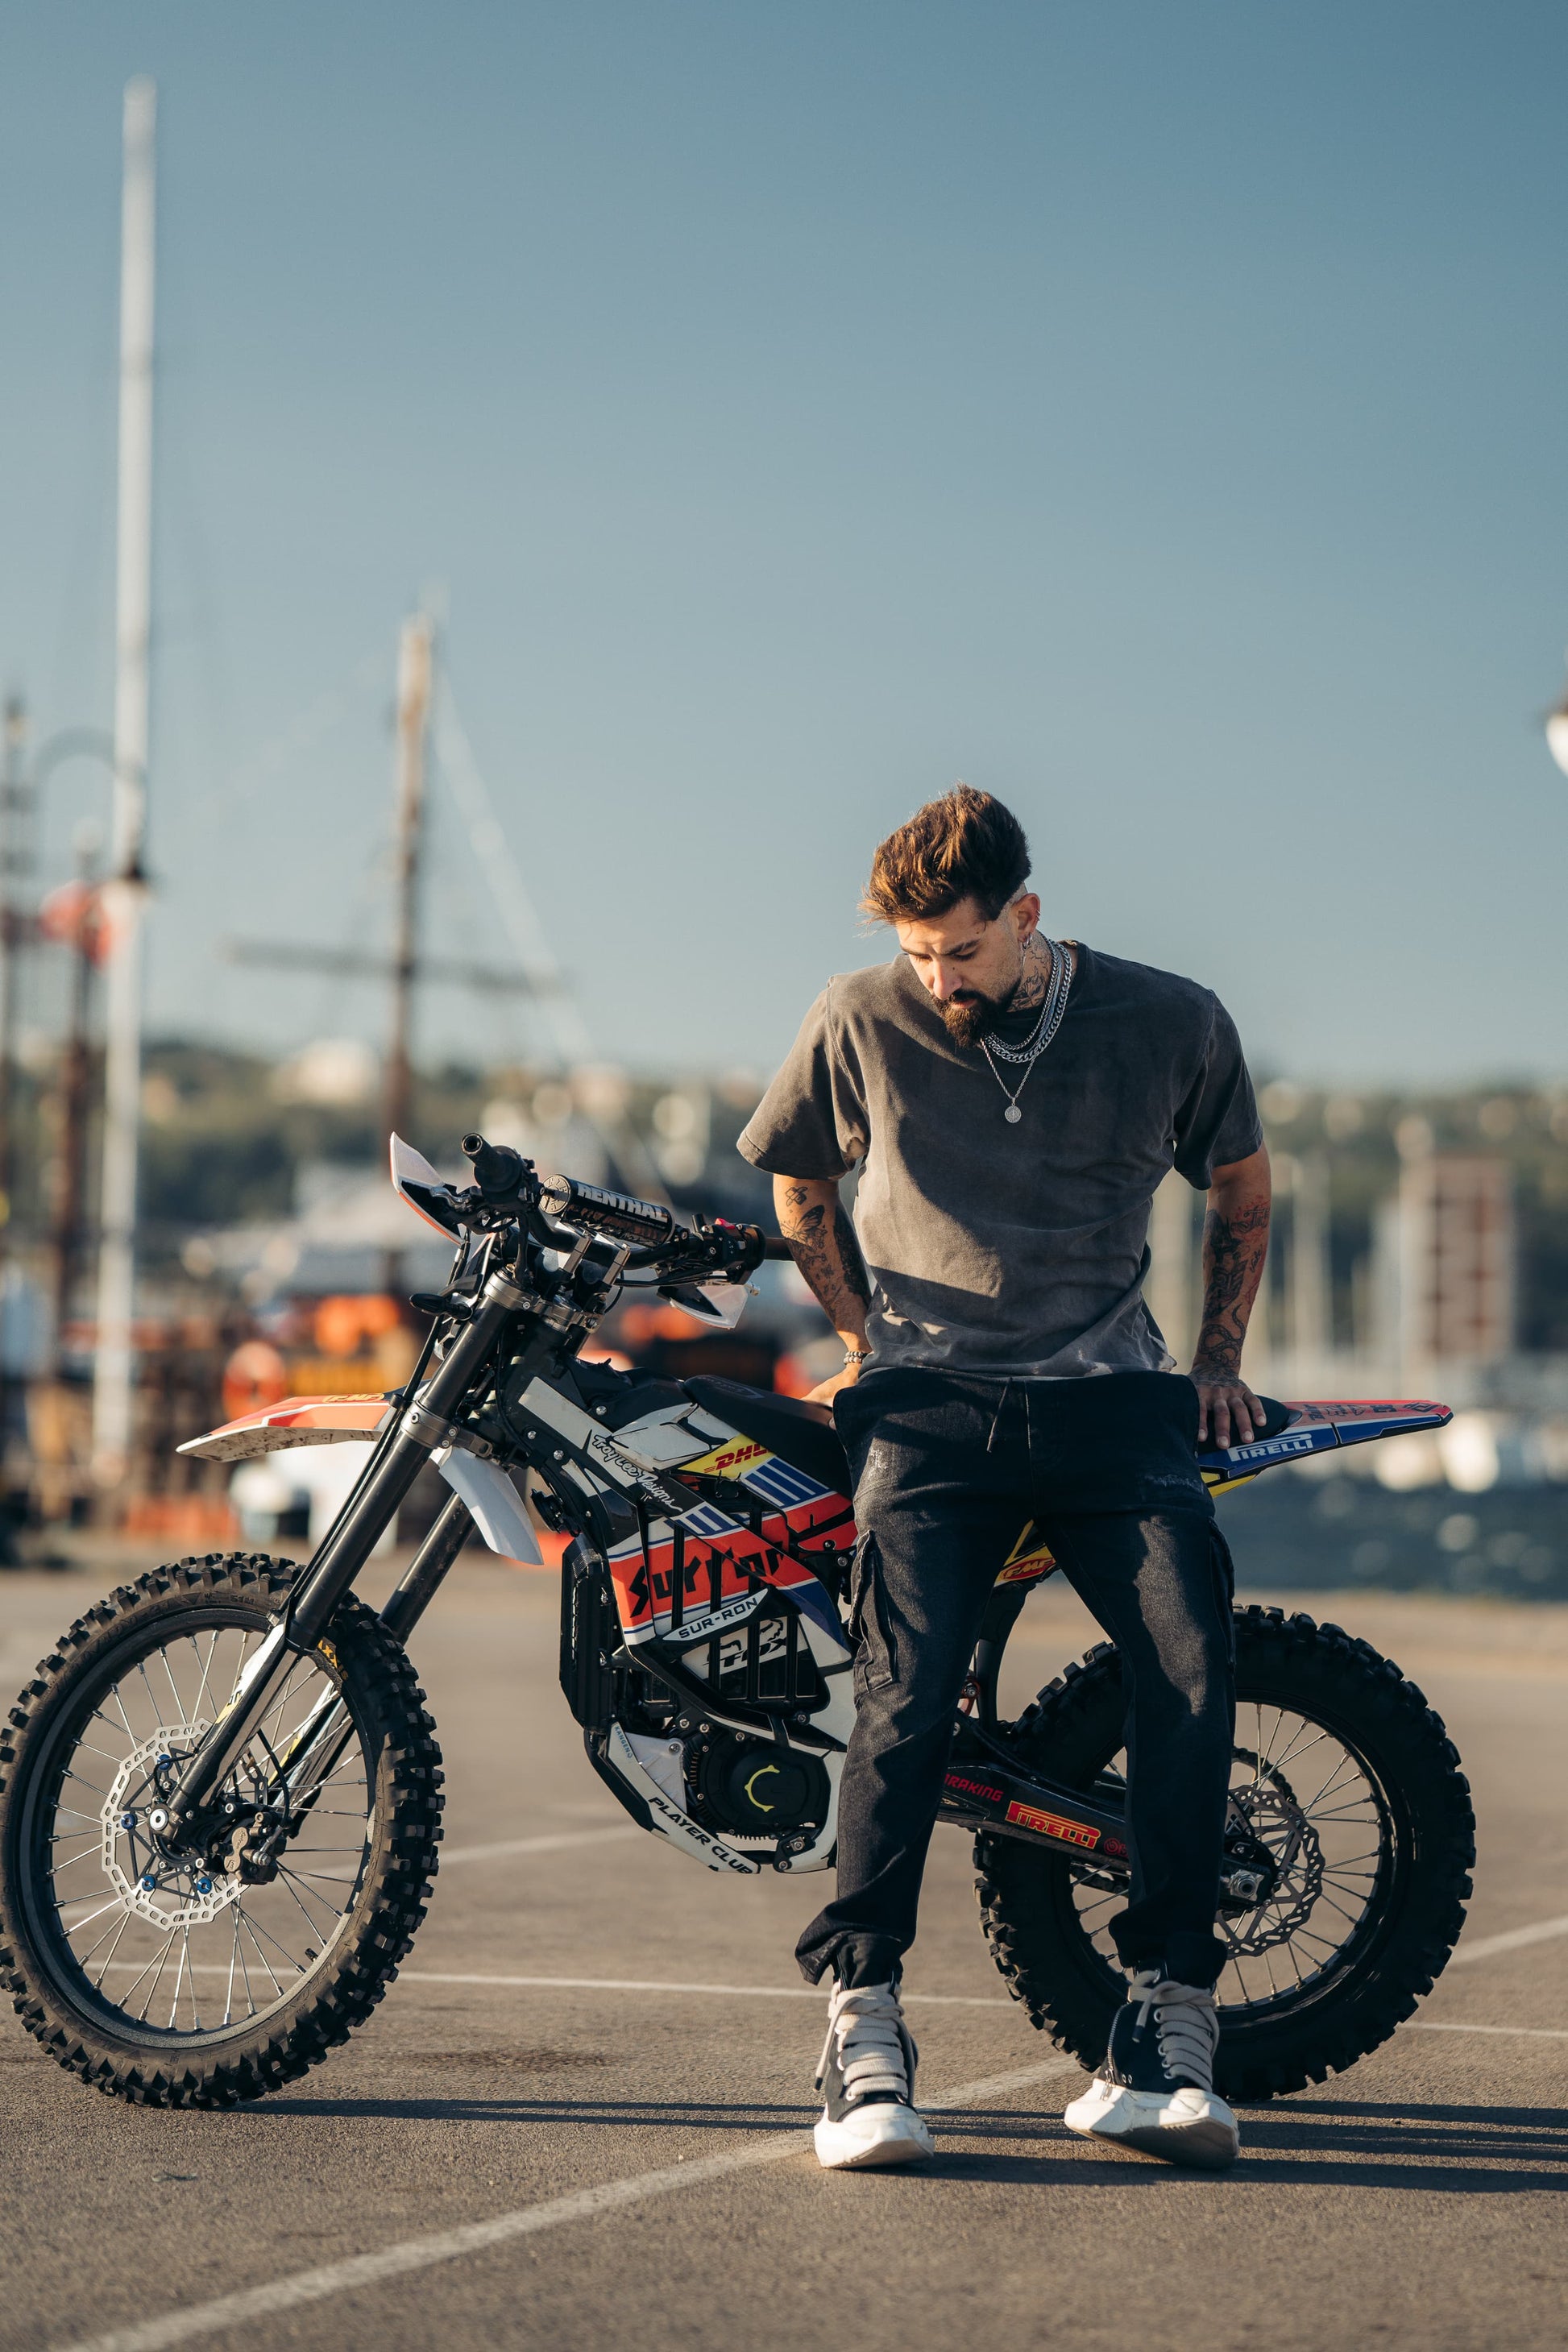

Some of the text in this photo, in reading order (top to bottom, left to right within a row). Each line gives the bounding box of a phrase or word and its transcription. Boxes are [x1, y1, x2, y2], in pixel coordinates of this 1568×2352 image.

[577, 1182, 669, 1223] RENTHAL
[715, 1444, 769, 1471] DHL
[1227, 1433, 1313, 1462] PIRELLI
[592, 1435, 683, 1512] Troy Lee Designs
[1006, 1558, 1053, 1578] FMF
[678, 1598, 758, 1639] SUR-RON
[648, 1797, 753, 1874] PLAYER CLUB
[1005, 1800, 1101, 1849] PIRELLI
